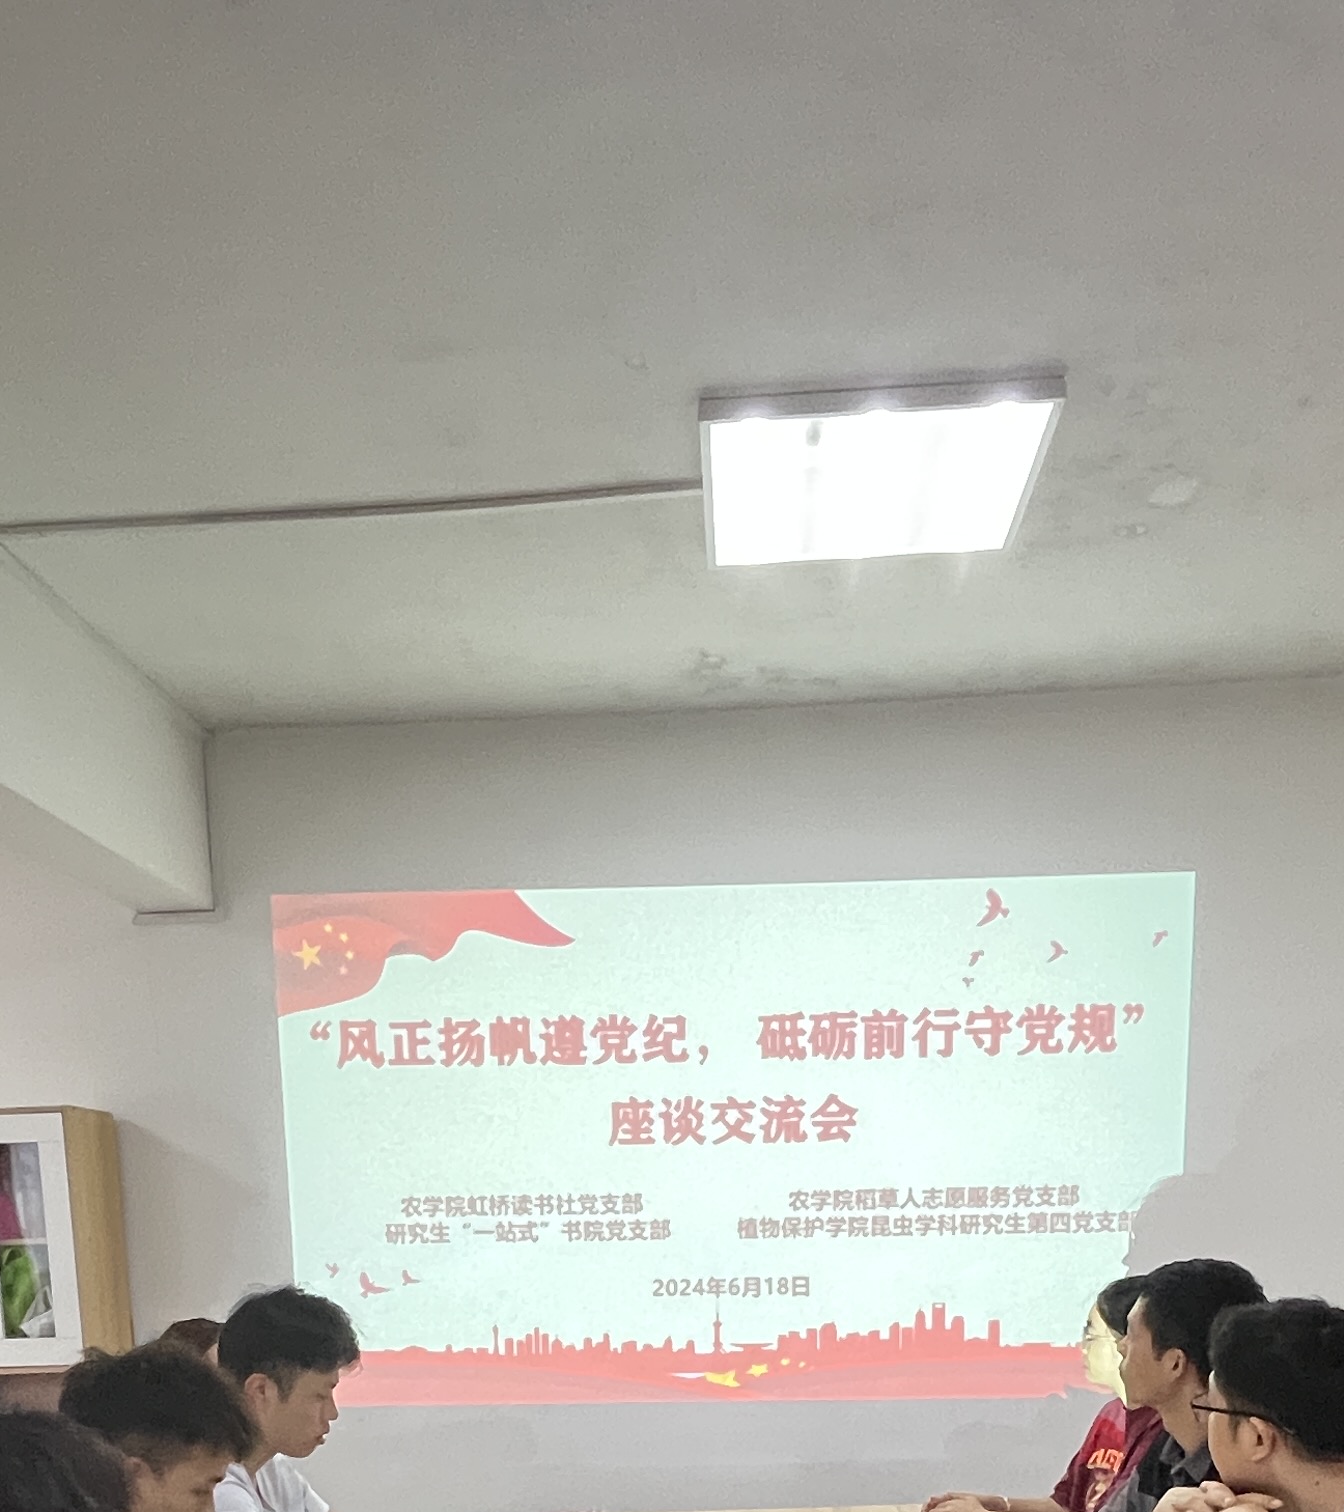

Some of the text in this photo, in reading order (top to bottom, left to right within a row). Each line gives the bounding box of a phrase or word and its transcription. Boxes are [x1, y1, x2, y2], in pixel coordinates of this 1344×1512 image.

[608, 1093, 859, 1146] 座谈交流会
[400, 1193, 644, 1218] 农学院虹桥读书社党支部
[788, 1184, 1081, 1212] 农学院稻草人志愿服务党支部
[652, 1275, 812, 1299] 2024年6月18日
